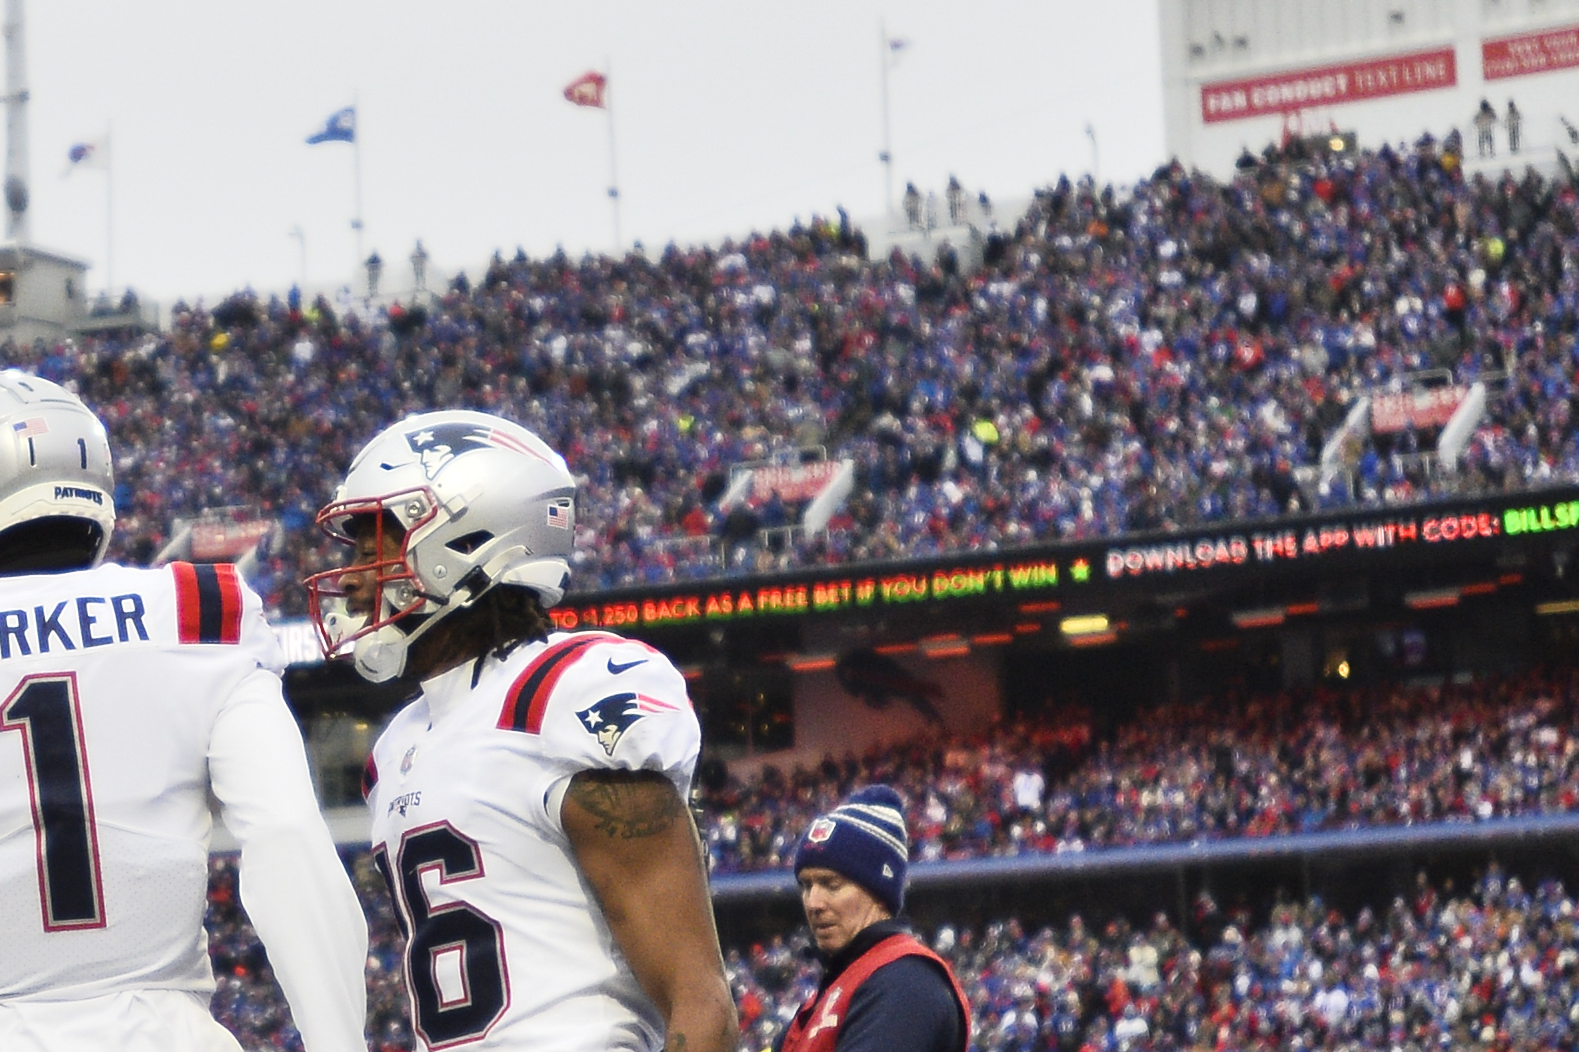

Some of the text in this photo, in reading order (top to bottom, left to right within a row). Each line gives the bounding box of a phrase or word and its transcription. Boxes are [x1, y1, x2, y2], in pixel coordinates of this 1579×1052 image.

[1209, 90, 1246, 113] FAN
[1252, 73, 1348, 106] CONDUCT
[54, 486, 103, 505] PATRIOTS
[550, 610, 578, 629] TO
[643, 597, 700, 623] BACK
[706, 592, 734, 616] AS
[738, 590, 753, 613] A
[757, 585, 809, 612] FREE
[813, 579, 852, 608] BET
[880, 572, 927, 600] YOU
[932, 563, 1004, 597] DON'T
[1009, 560, 1058, 588] WIN
[1107, 536, 1248, 578] DOWNLOAD
[1253, 533, 1298, 559] THE
[1302, 526, 1349, 552] APP
[1353, 521, 1417, 548] WITH
